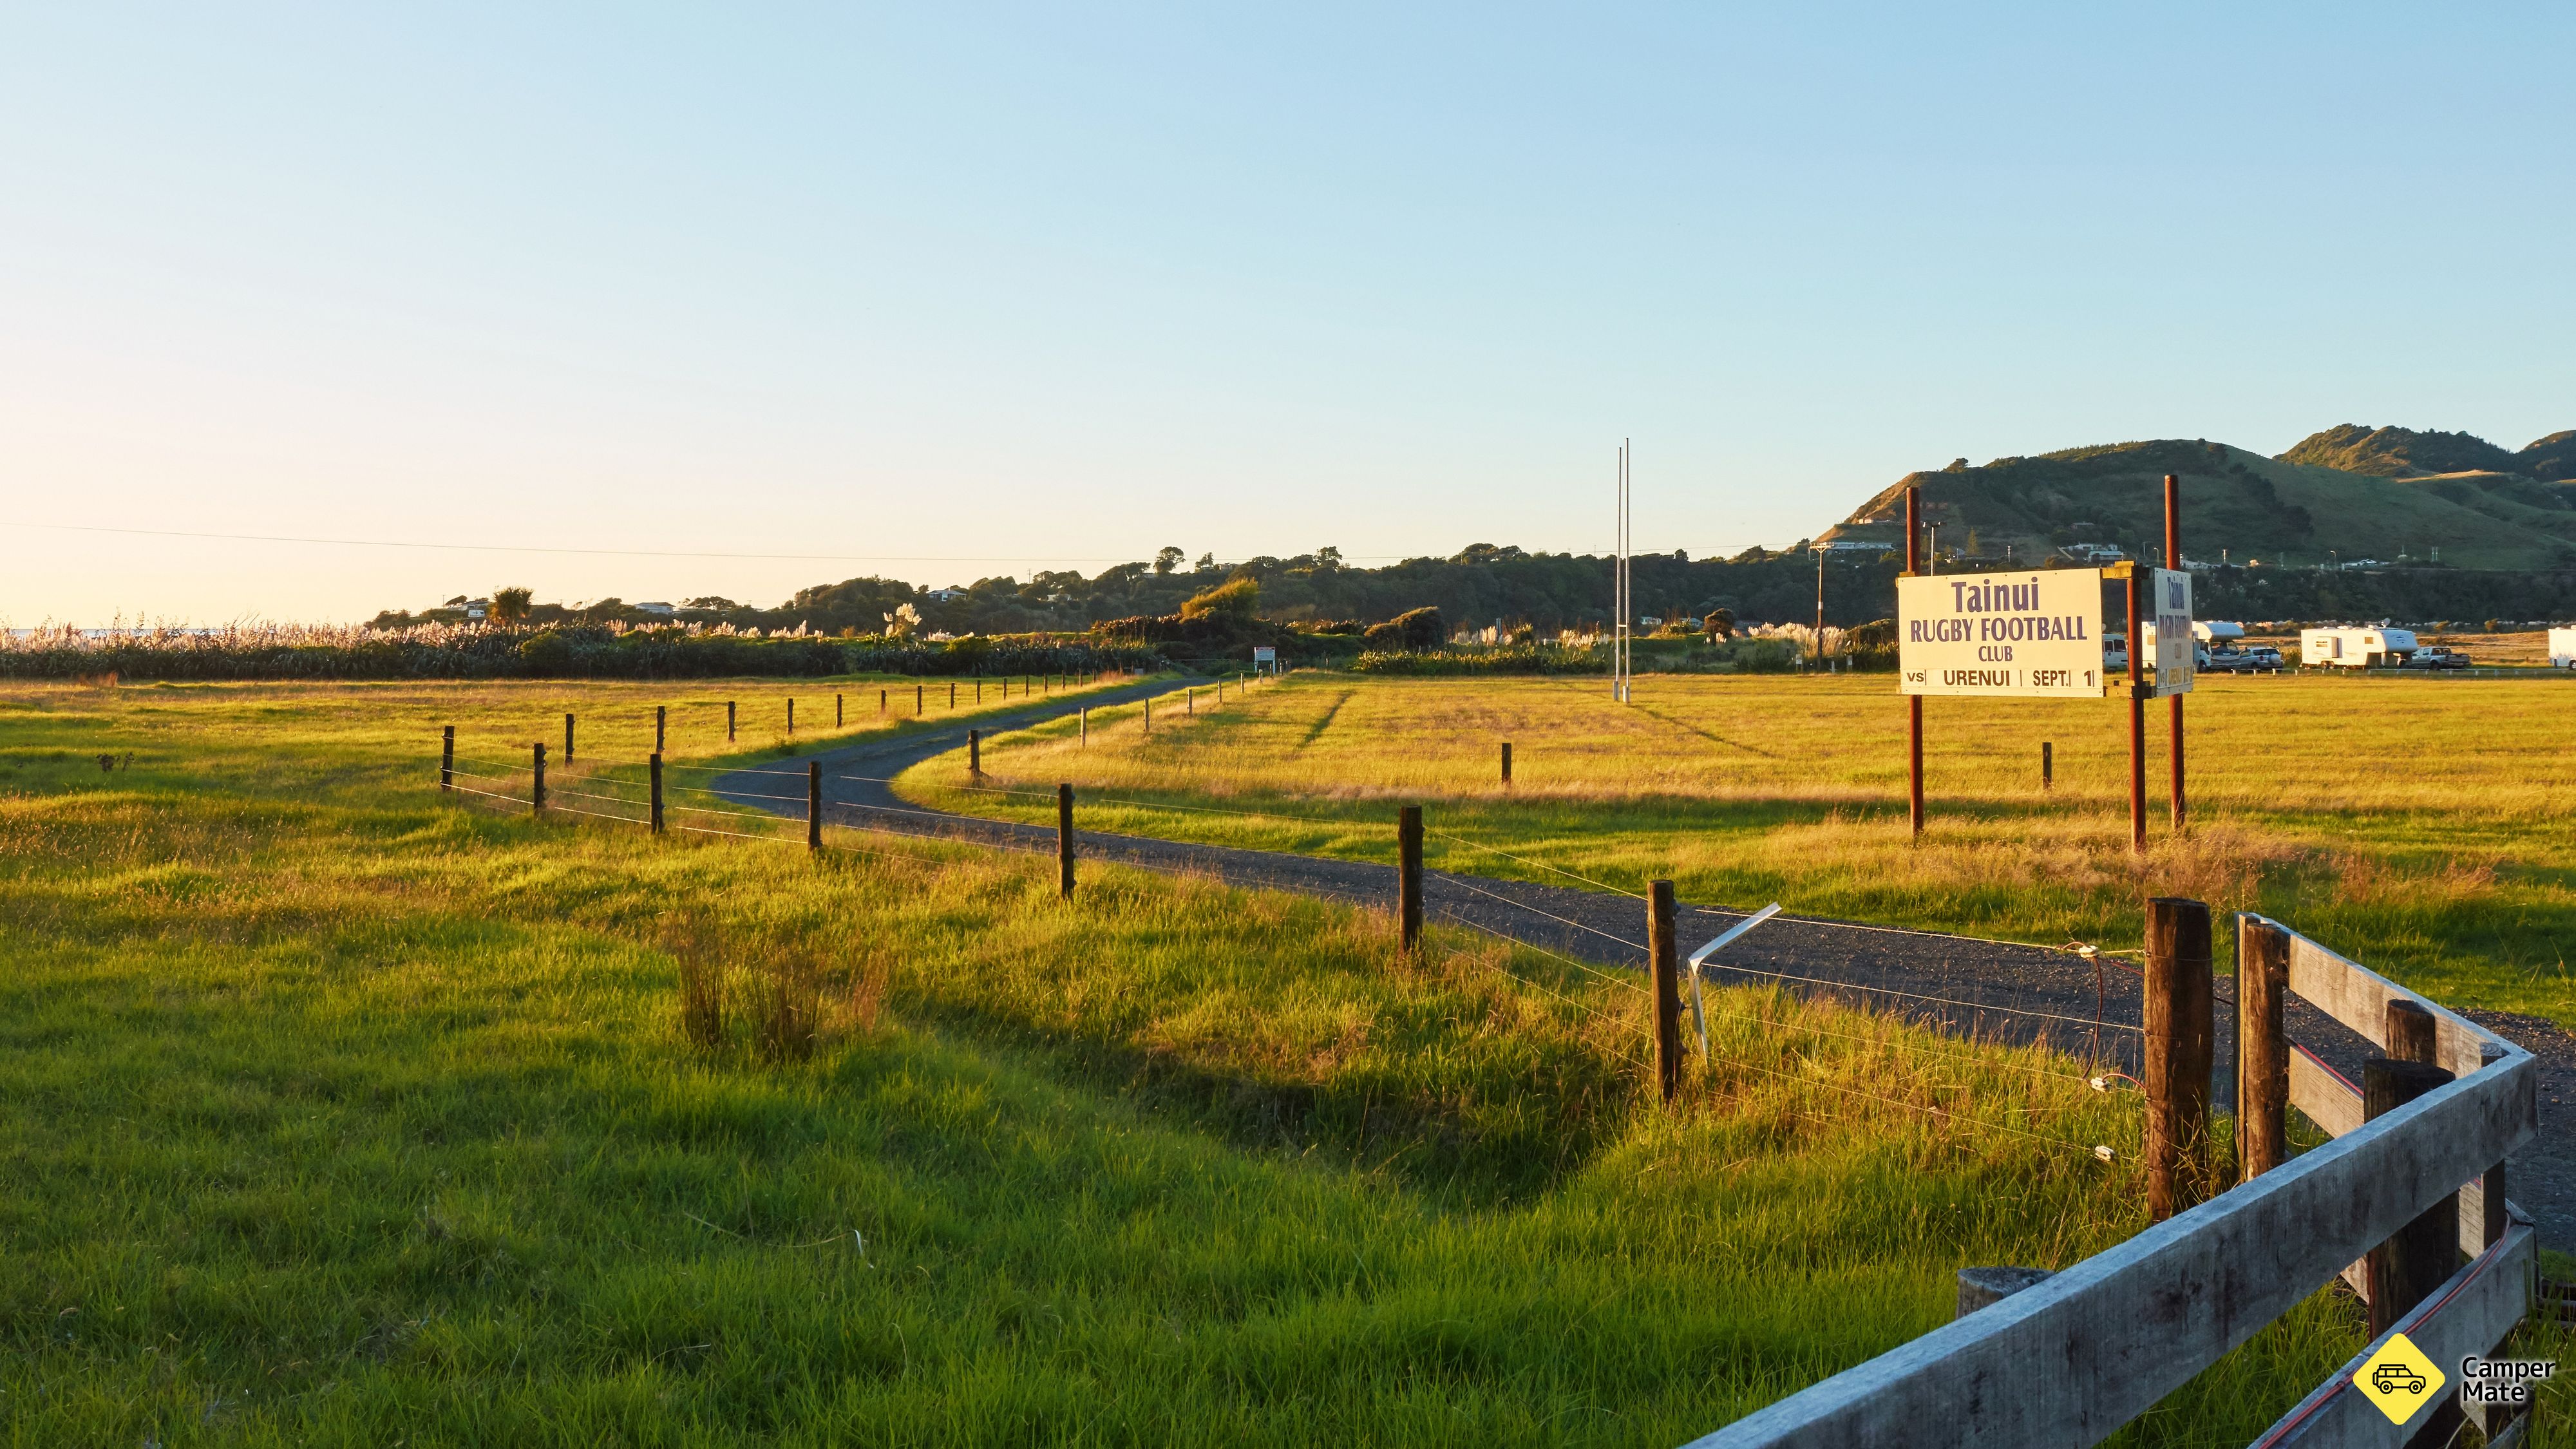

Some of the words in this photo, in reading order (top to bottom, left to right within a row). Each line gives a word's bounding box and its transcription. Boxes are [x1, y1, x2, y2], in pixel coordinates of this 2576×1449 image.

[1951, 576, 2039, 612] Tainui
[1911, 618, 1973, 643] RUGBY
[1982, 616, 2088, 641] FOOTBALL
[1978, 645, 2013, 662] CLUB
[1944, 670, 2010, 687] URENUI
[2033, 670, 2069, 687] SEPT.
[2084, 670, 2092, 687] 1
